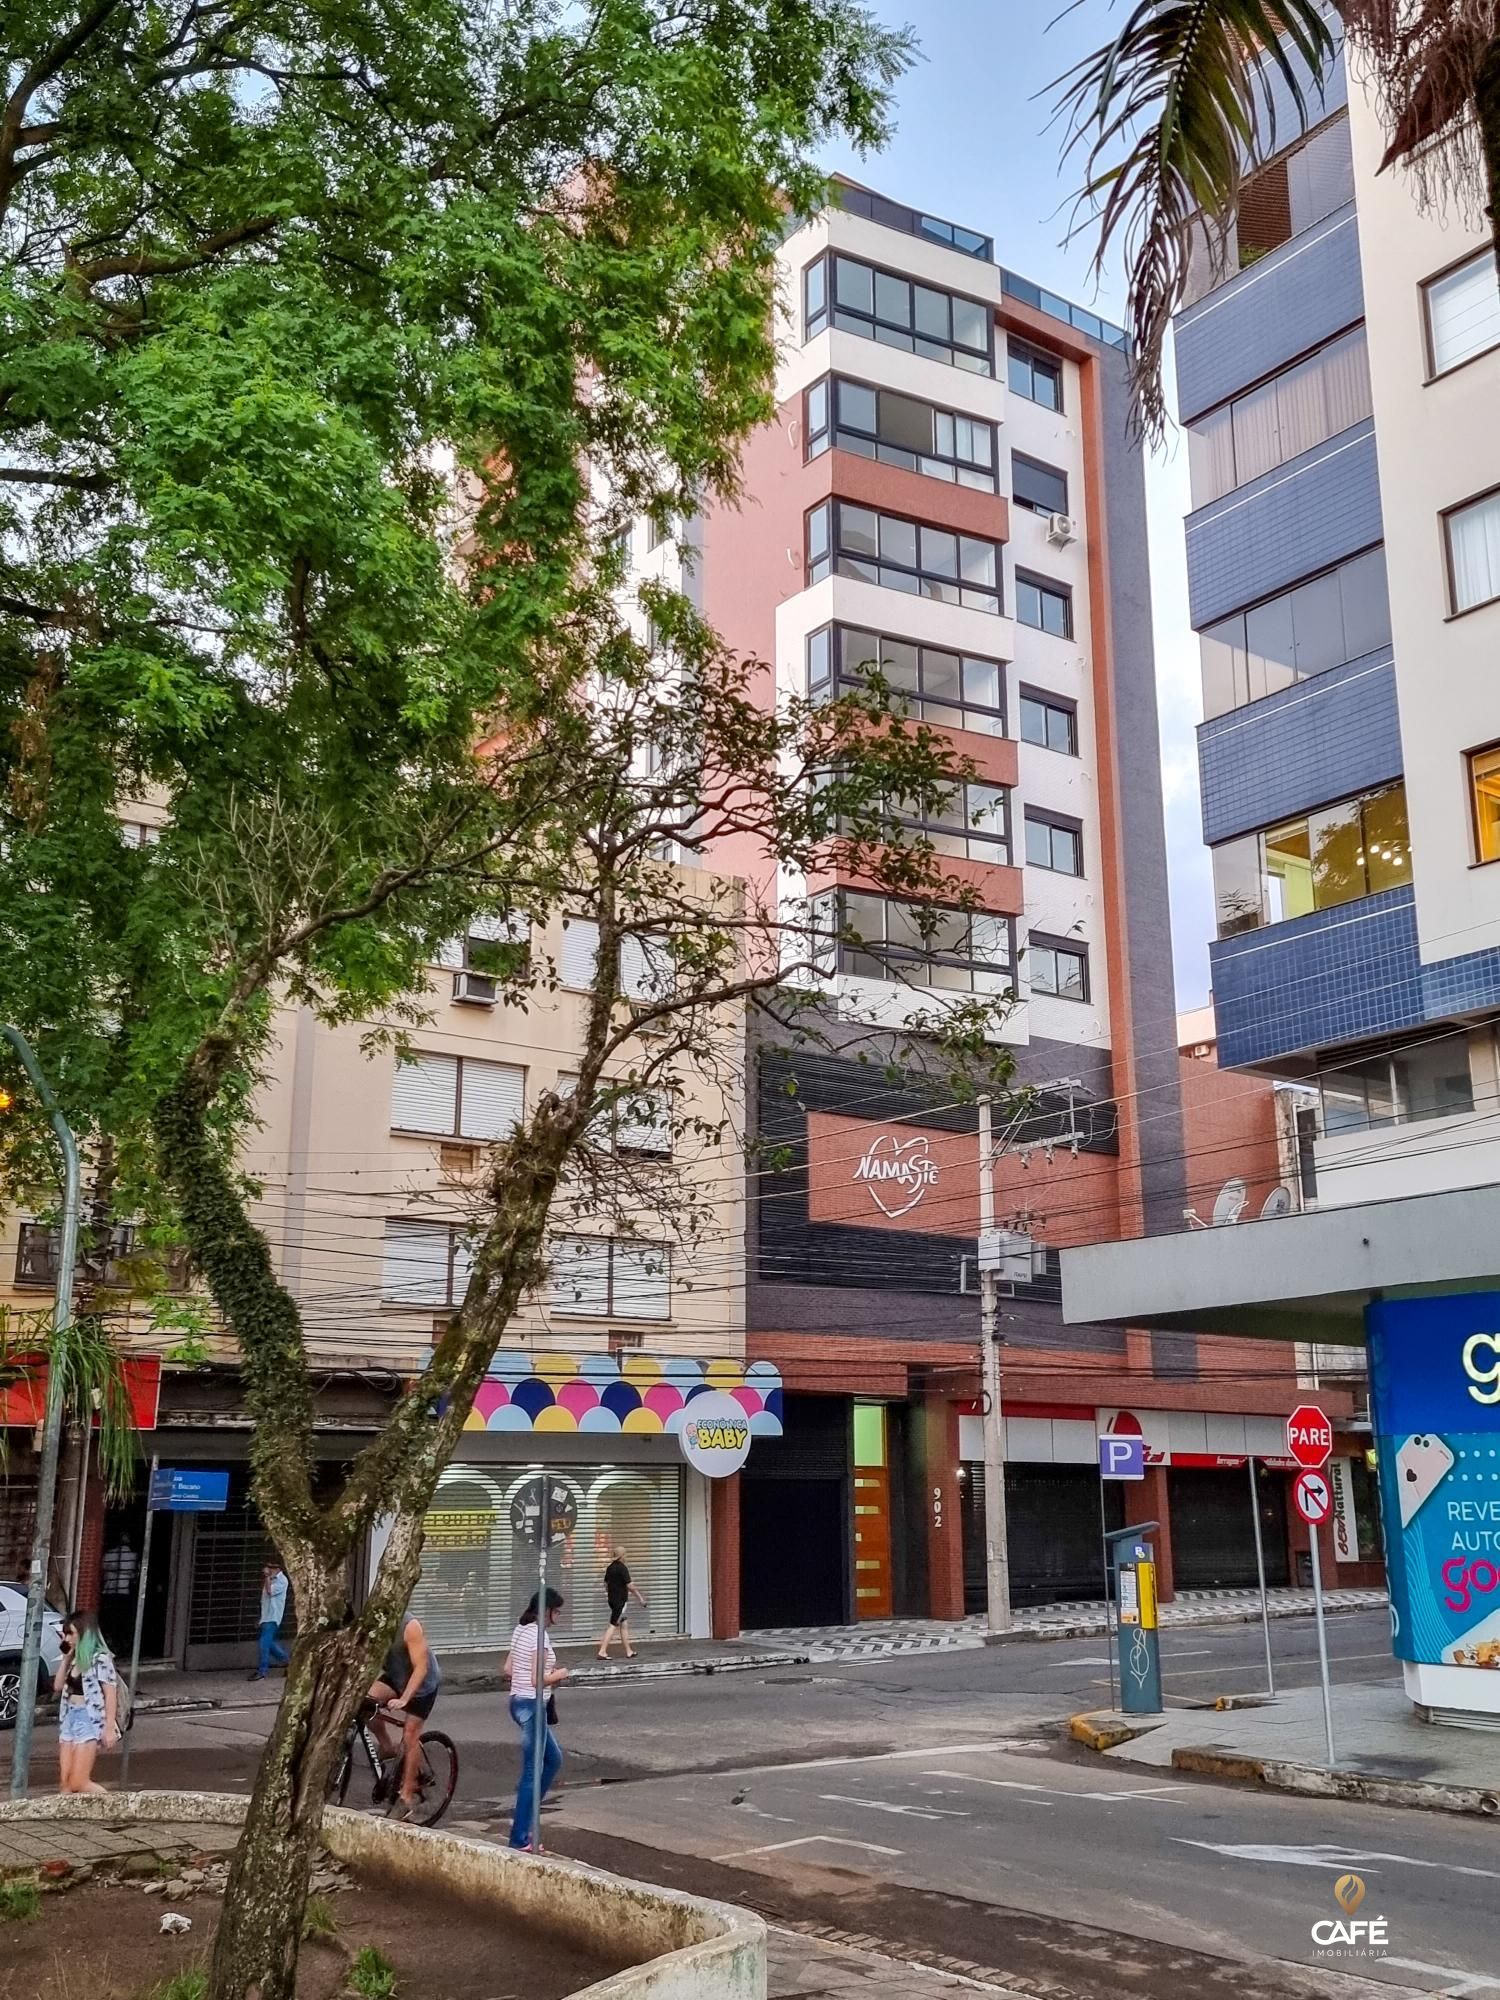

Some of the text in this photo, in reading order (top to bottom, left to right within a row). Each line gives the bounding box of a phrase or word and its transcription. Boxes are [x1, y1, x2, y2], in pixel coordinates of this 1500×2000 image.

[697, 1428, 748, 1450] BABY
[1290, 1427, 1329, 1446] PARE
[1109, 1441, 1132, 1472] P
[933, 1487, 942, 1528] 902
